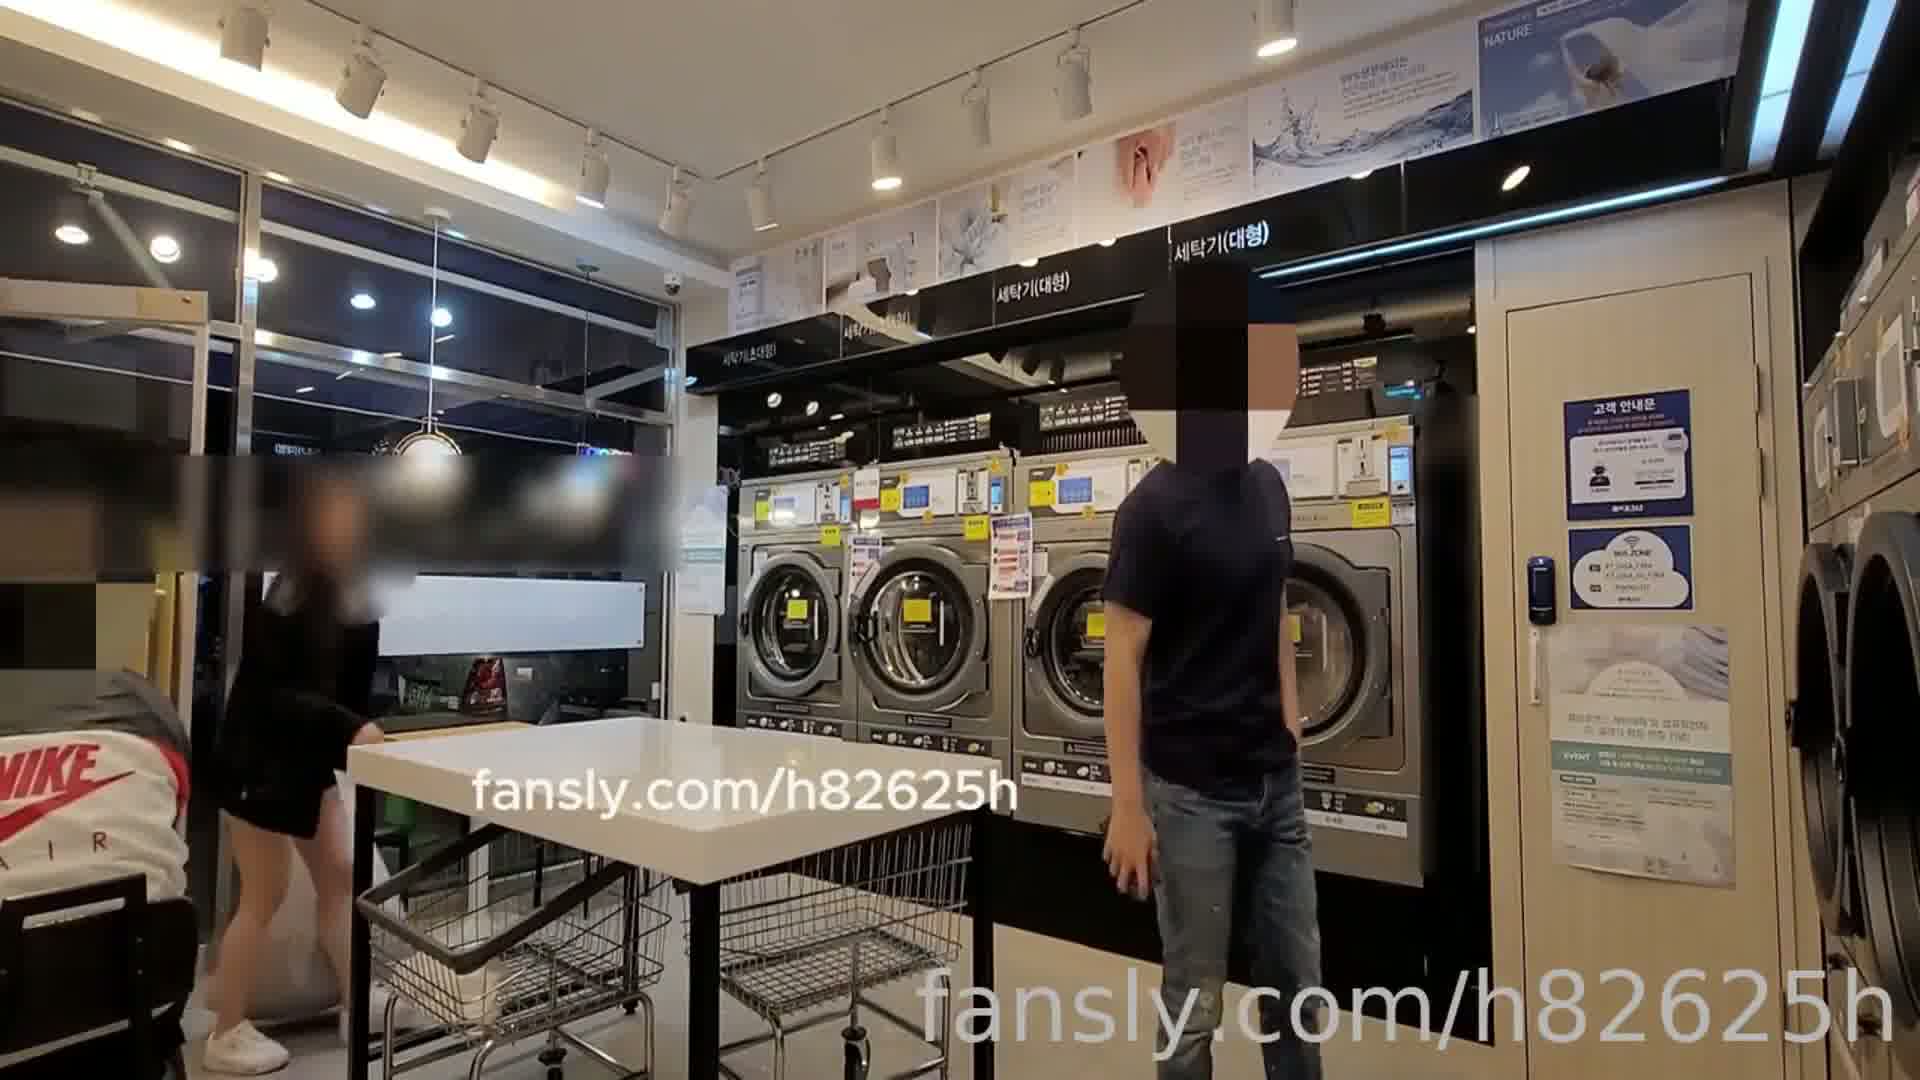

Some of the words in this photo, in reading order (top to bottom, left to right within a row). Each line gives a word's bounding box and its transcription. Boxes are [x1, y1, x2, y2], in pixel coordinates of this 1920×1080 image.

[1484, 23, 1535, 49] NATURE
[1174, 219, 1270, 263] 세탁기(대형)
[996, 271, 1070, 304] 세탁기(대형)
[1593, 401, 1617, 416] 고객
